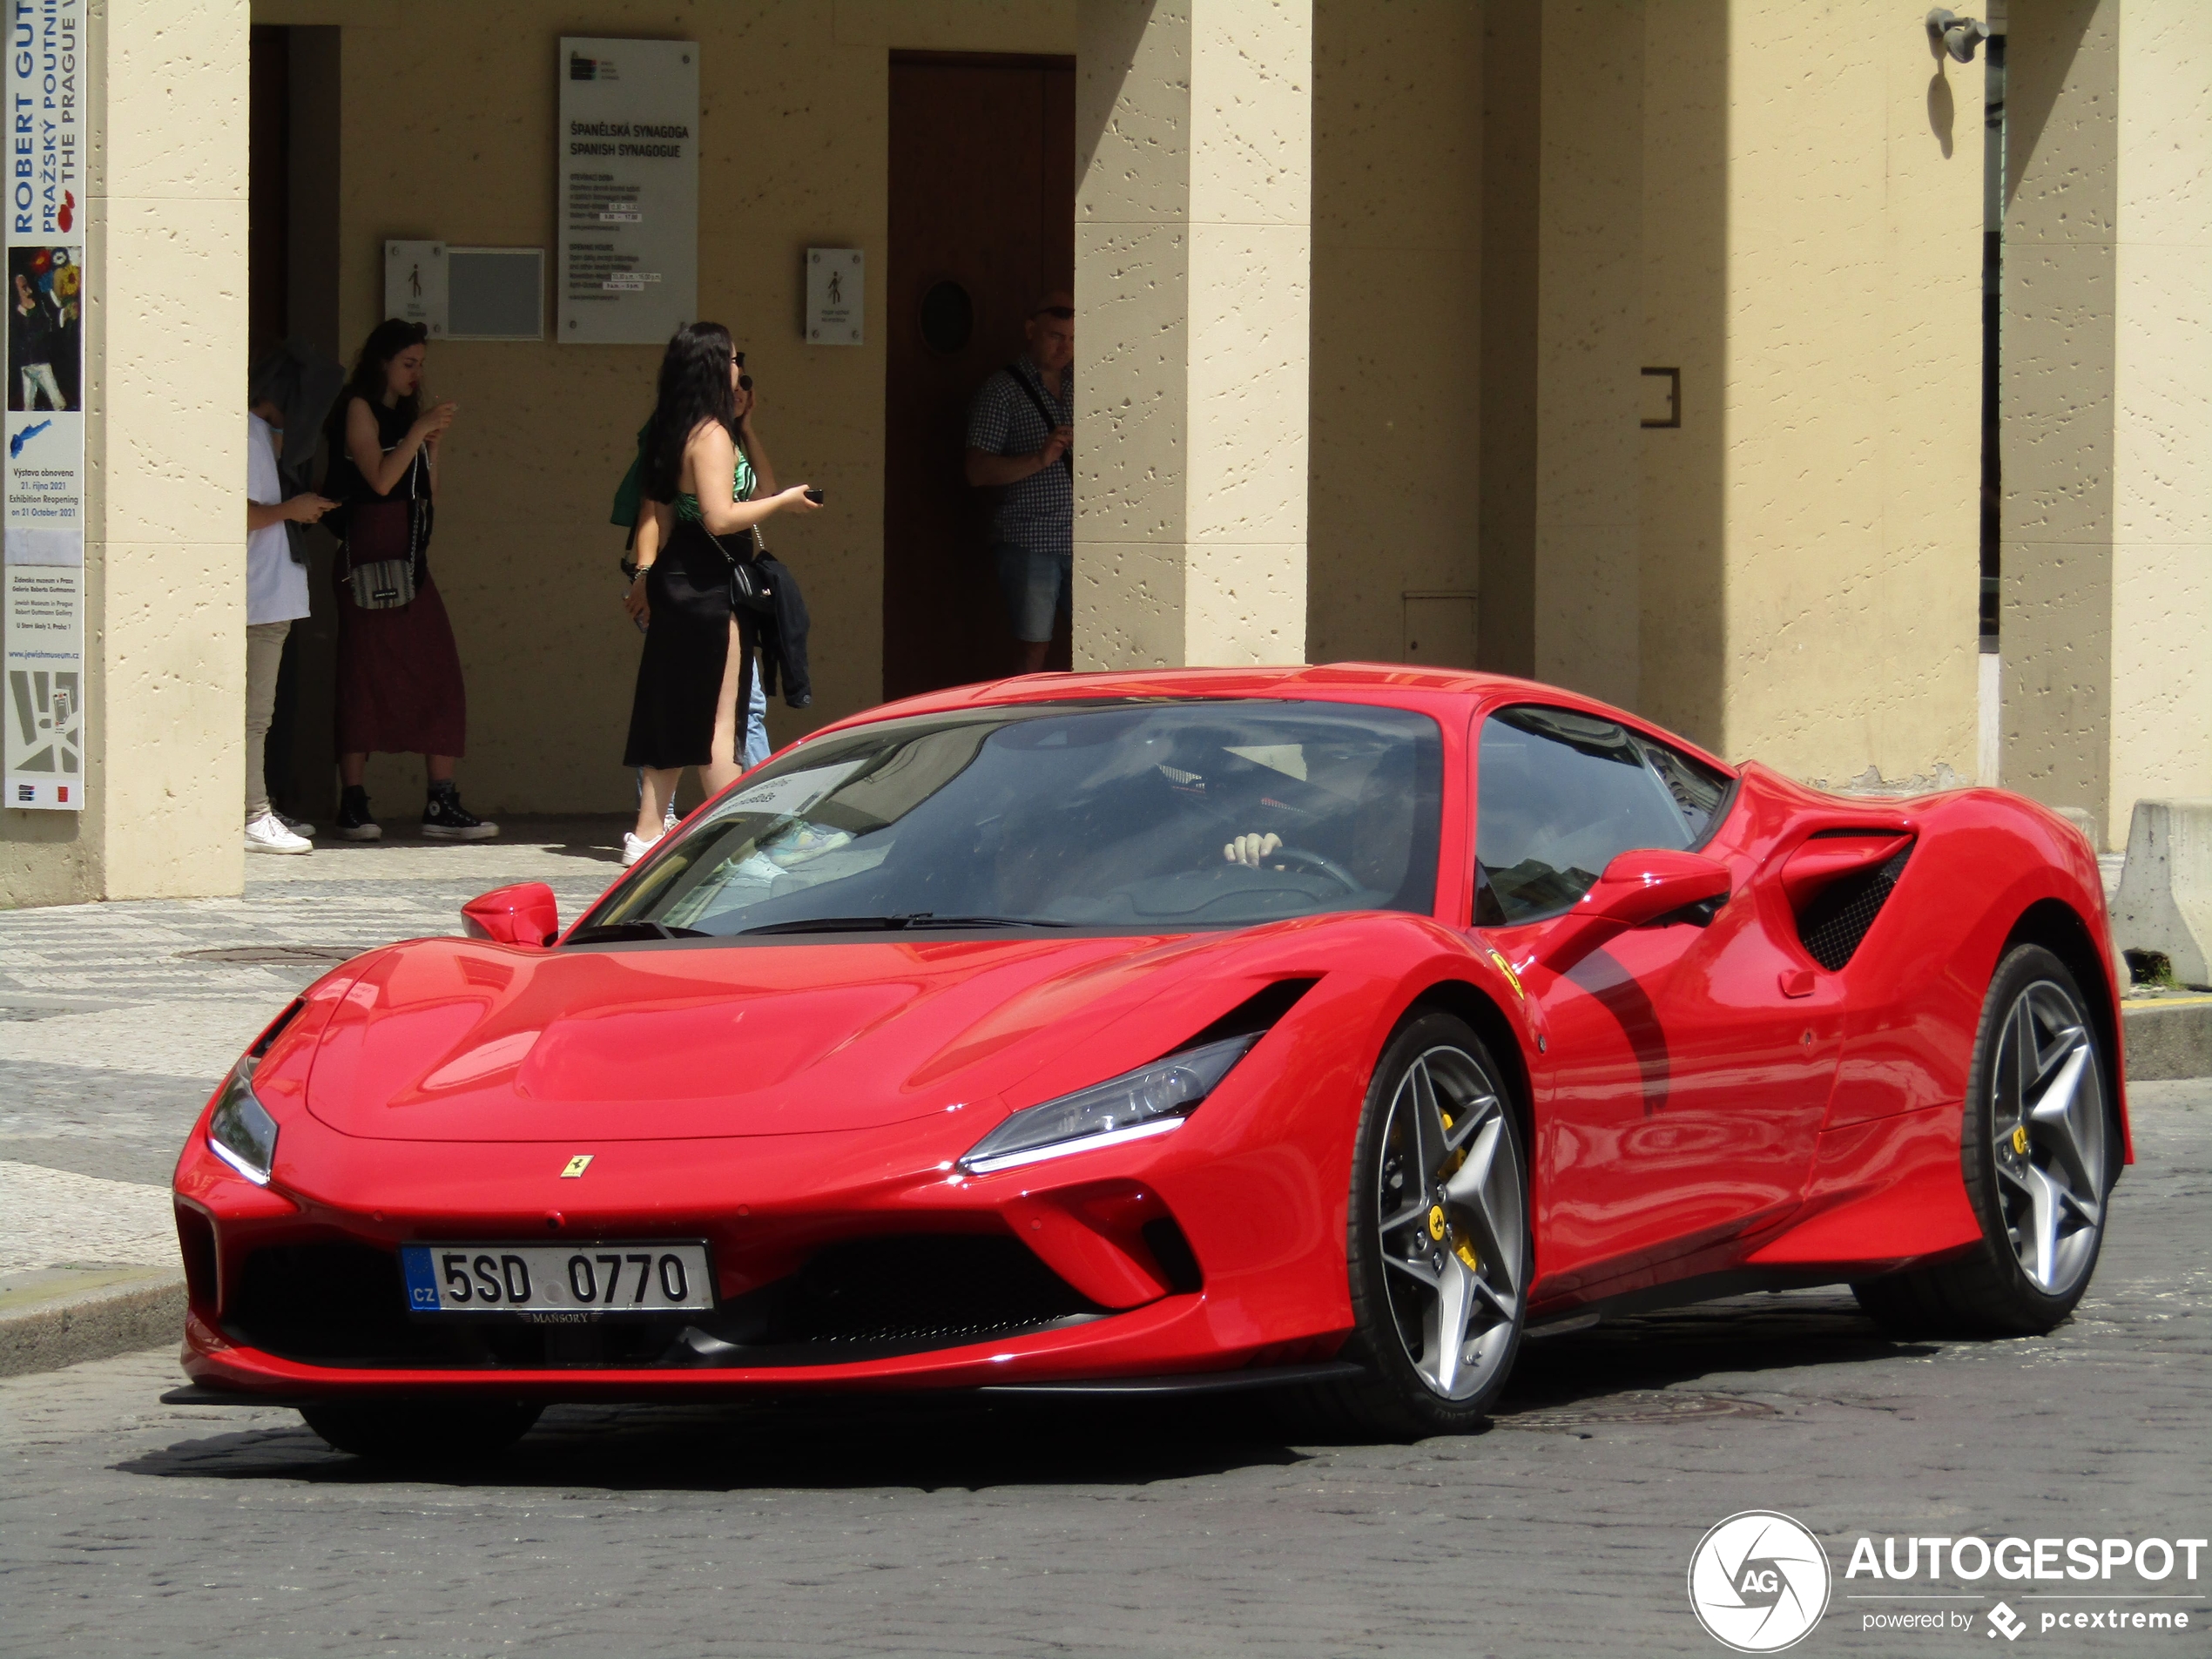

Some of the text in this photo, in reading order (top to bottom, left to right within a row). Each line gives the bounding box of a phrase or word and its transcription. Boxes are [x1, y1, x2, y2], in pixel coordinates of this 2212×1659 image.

[62, 17, 76, 123] PRAGUE
[570, 121, 689, 138] ŠPANĚLSKÁ SYNAGOGA
[570, 143, 681, 158] SPANISH SYNAGOGUE
[16, 93, 33, 233] ROBERT
[62, 134, 75, 183] THE
[39, 118, 56, 233] PRAŽSKÝ
[13, 469, 39, 478] Výstava
[51, 482, 66, 490] 2021
[10, 495, 78, 505] Exhibition Reopening
[59, 509, 76, 517] 2021
[9, 650, 79, 659] www.jewishmuseum.cz
[442, 1253, 689, 1304] 5SD 0770
[414, 1288, 435, 1302] CZ
[533, 1312, 589, 1324] MANSORY
